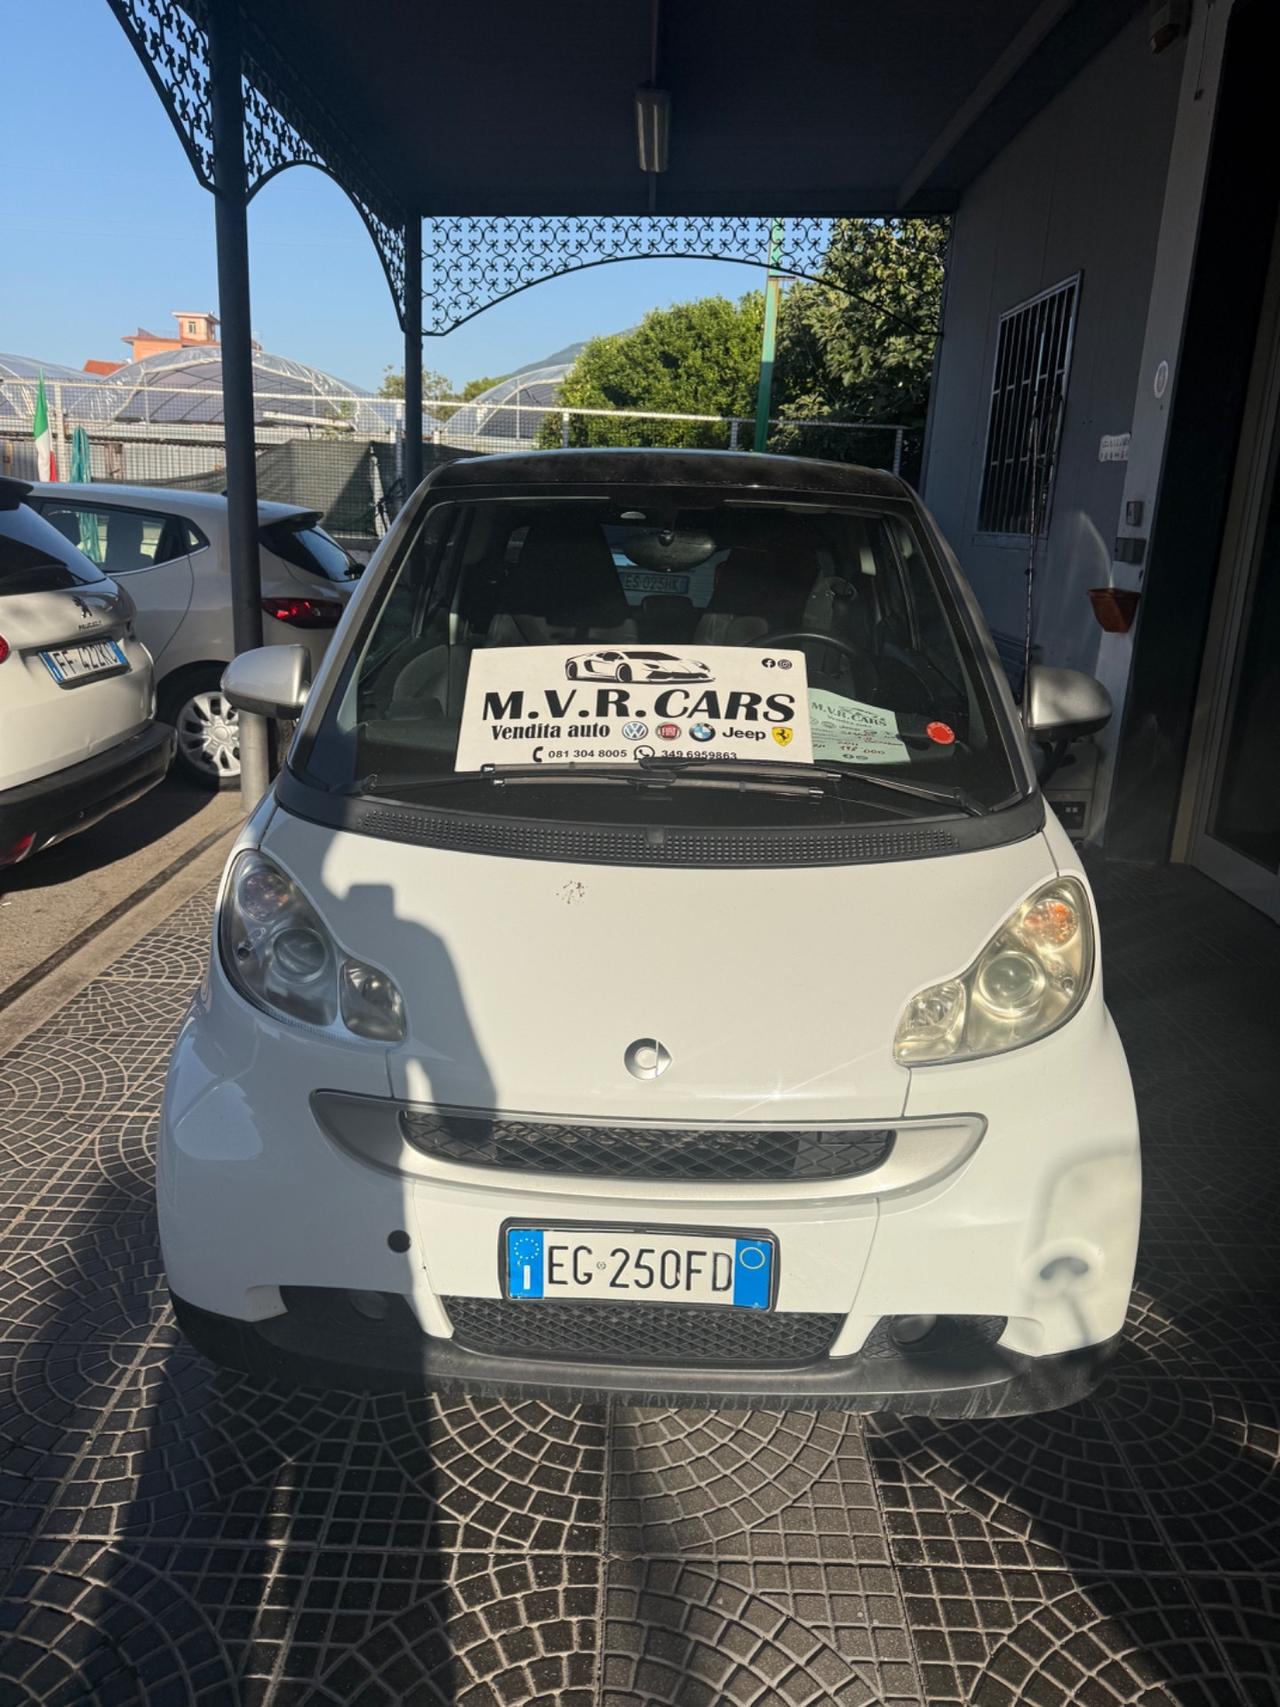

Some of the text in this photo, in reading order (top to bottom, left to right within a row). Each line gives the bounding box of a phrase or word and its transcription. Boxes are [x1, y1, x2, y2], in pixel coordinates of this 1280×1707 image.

[482, 688, 796, 723] M.V.R.CARS
[491, 723, 561, 740] Vendita
[567, 722, 611, 738] auto
[722, 727, 766, 741] Jeep
[548, 749, 628, 758] 081 304 8005
[547, 1245, 733, 1292] EG 250FD
